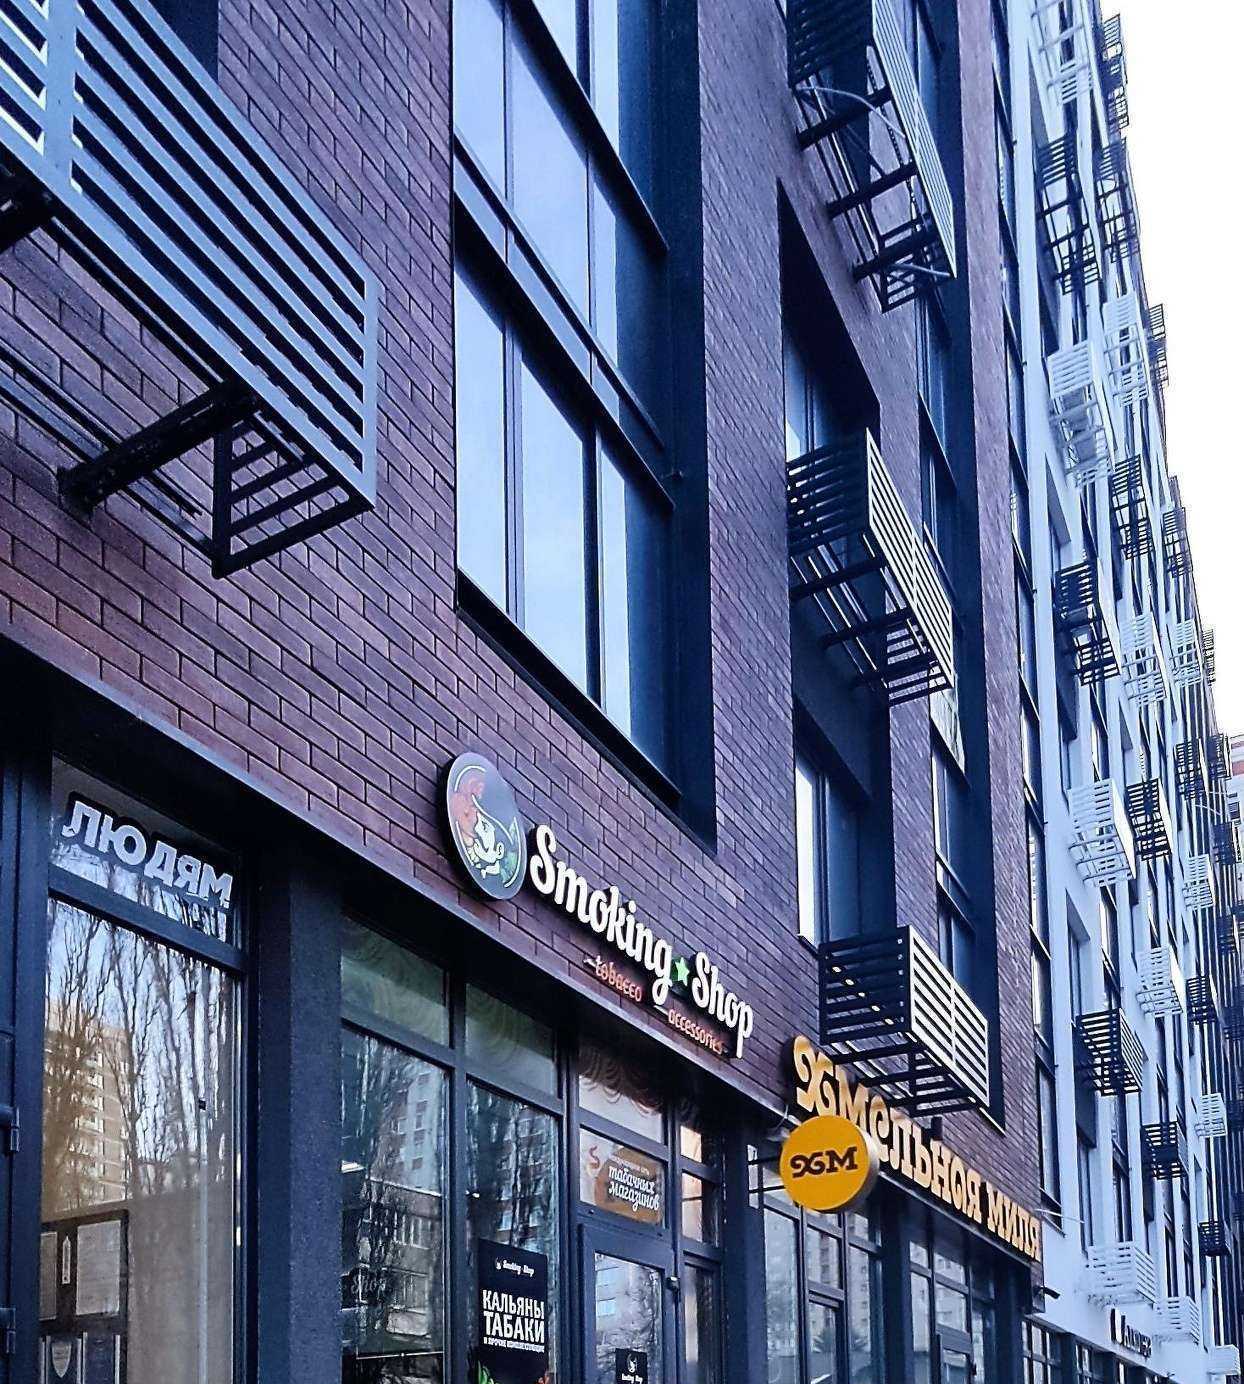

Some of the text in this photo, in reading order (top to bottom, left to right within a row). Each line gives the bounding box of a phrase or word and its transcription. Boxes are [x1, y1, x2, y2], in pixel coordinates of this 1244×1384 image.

[61, 800, 233, 908] ЛЮДЯМ
[530, 824, 754, 1058] Smoking Shop
[594, 956, 723, 1055] tobacco accessories
[608, 1181, 660, 1212] магазинов
[609, 1166, 655, 1194] табачных
[482, 1289, 545, 1320] КАЛЬЯНЫ
[483, 1311, 545, 1344] ТАБАКИ
